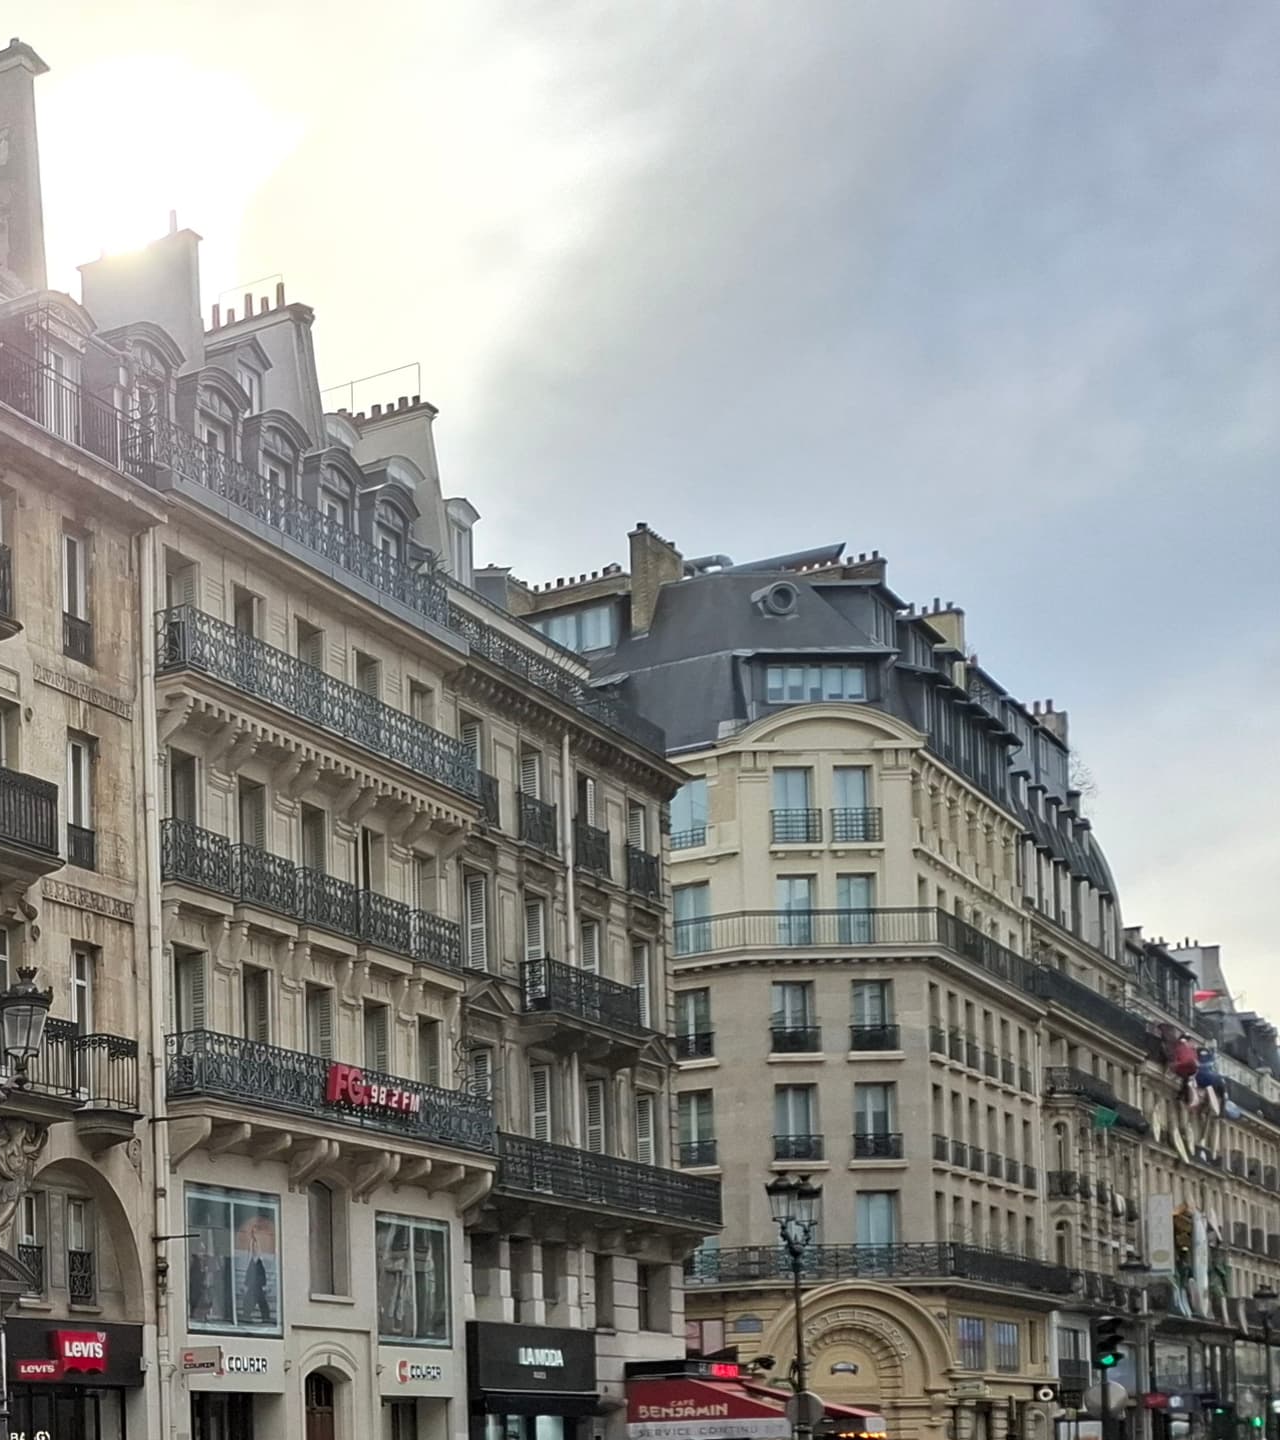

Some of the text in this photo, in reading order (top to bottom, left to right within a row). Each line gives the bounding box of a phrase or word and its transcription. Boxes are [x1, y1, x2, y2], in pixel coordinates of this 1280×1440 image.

[402, 1092, 420, 1112] FM
[228, 1356, 267, 1373] COURIR
[638, 1403, 728, 1418] BENJAMIN
